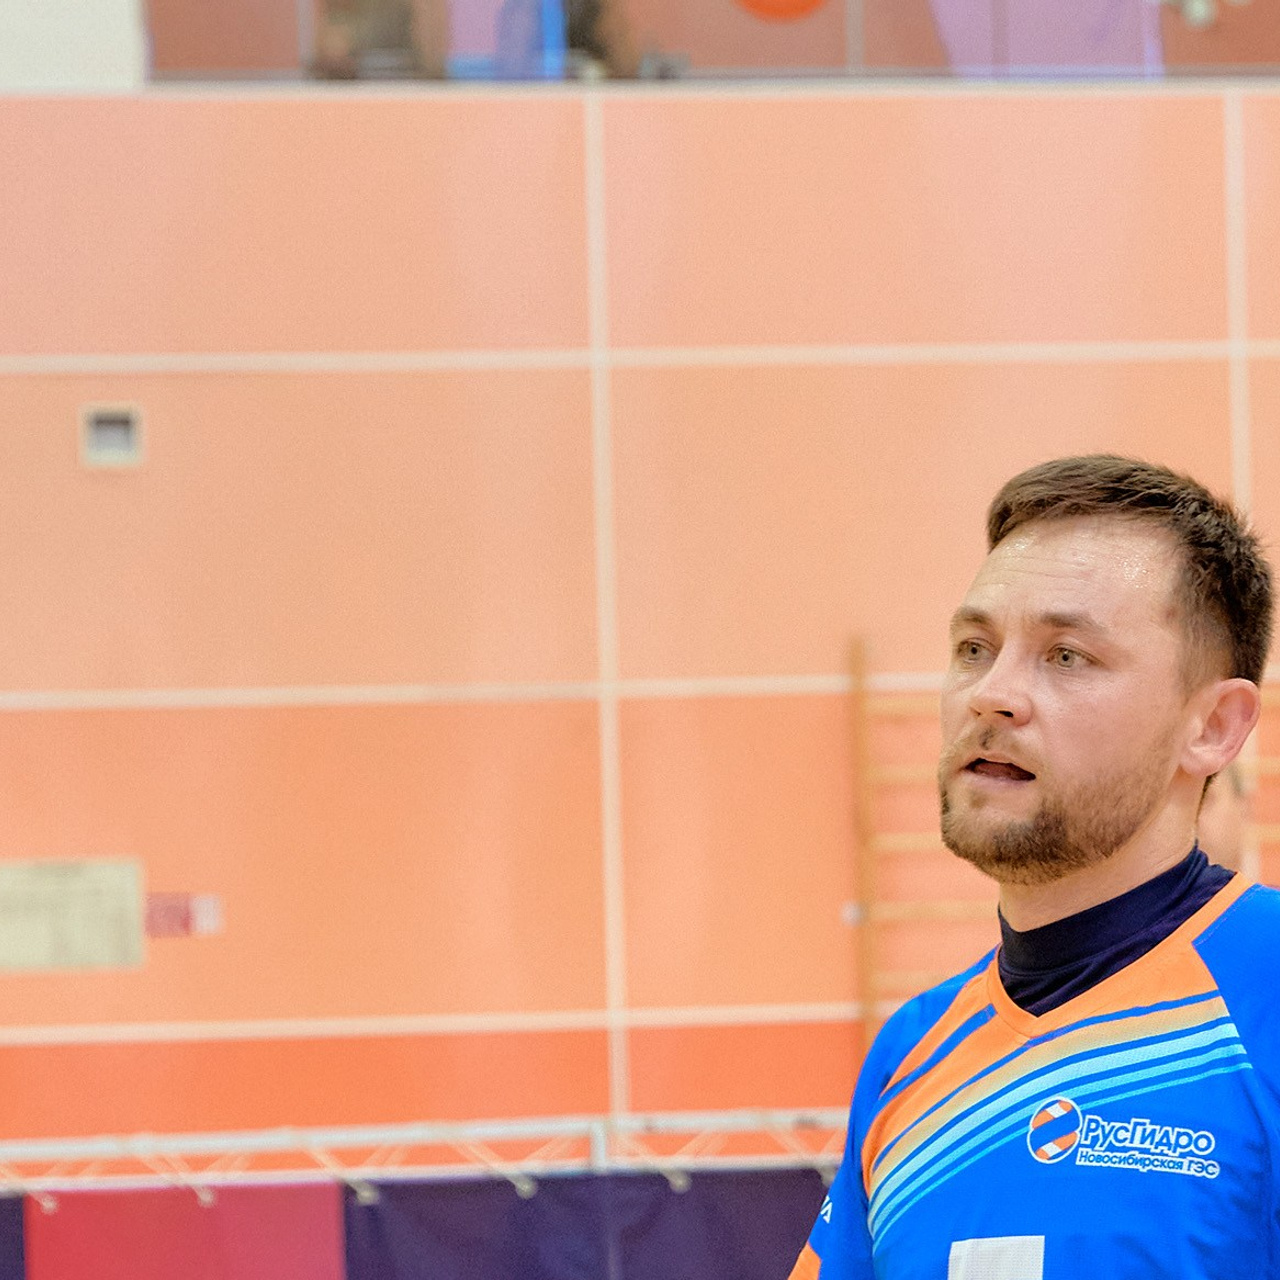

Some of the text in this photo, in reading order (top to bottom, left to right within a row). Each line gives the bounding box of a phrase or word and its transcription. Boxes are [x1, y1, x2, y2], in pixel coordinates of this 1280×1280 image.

[1082, 1116, 1214, 1155] РусГидро
[1078, 1150, 1219, 1177] Новосибирская ГЭС
